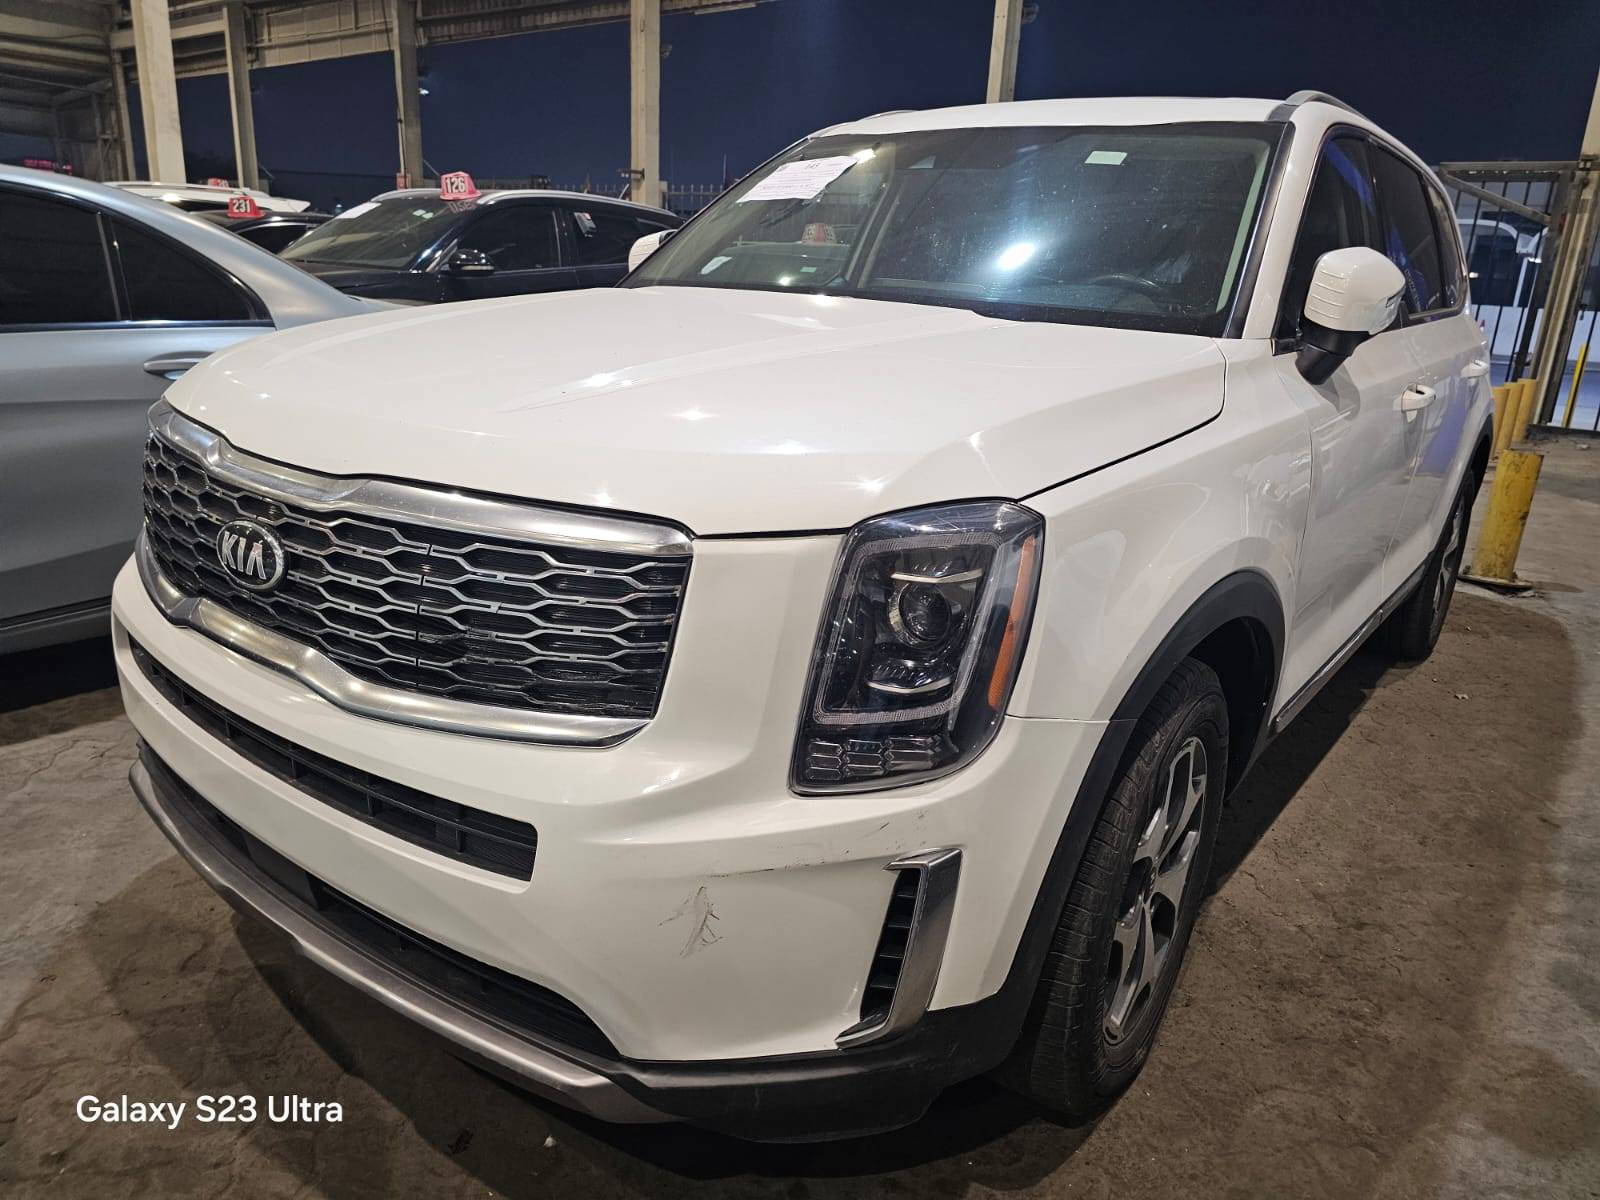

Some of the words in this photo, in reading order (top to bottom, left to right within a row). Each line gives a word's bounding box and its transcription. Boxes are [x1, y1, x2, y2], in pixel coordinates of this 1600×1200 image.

[445, 176, 466, 193] 126
[233, 199, 250, 213] 231
[221, 530, 267, 580] KIA
